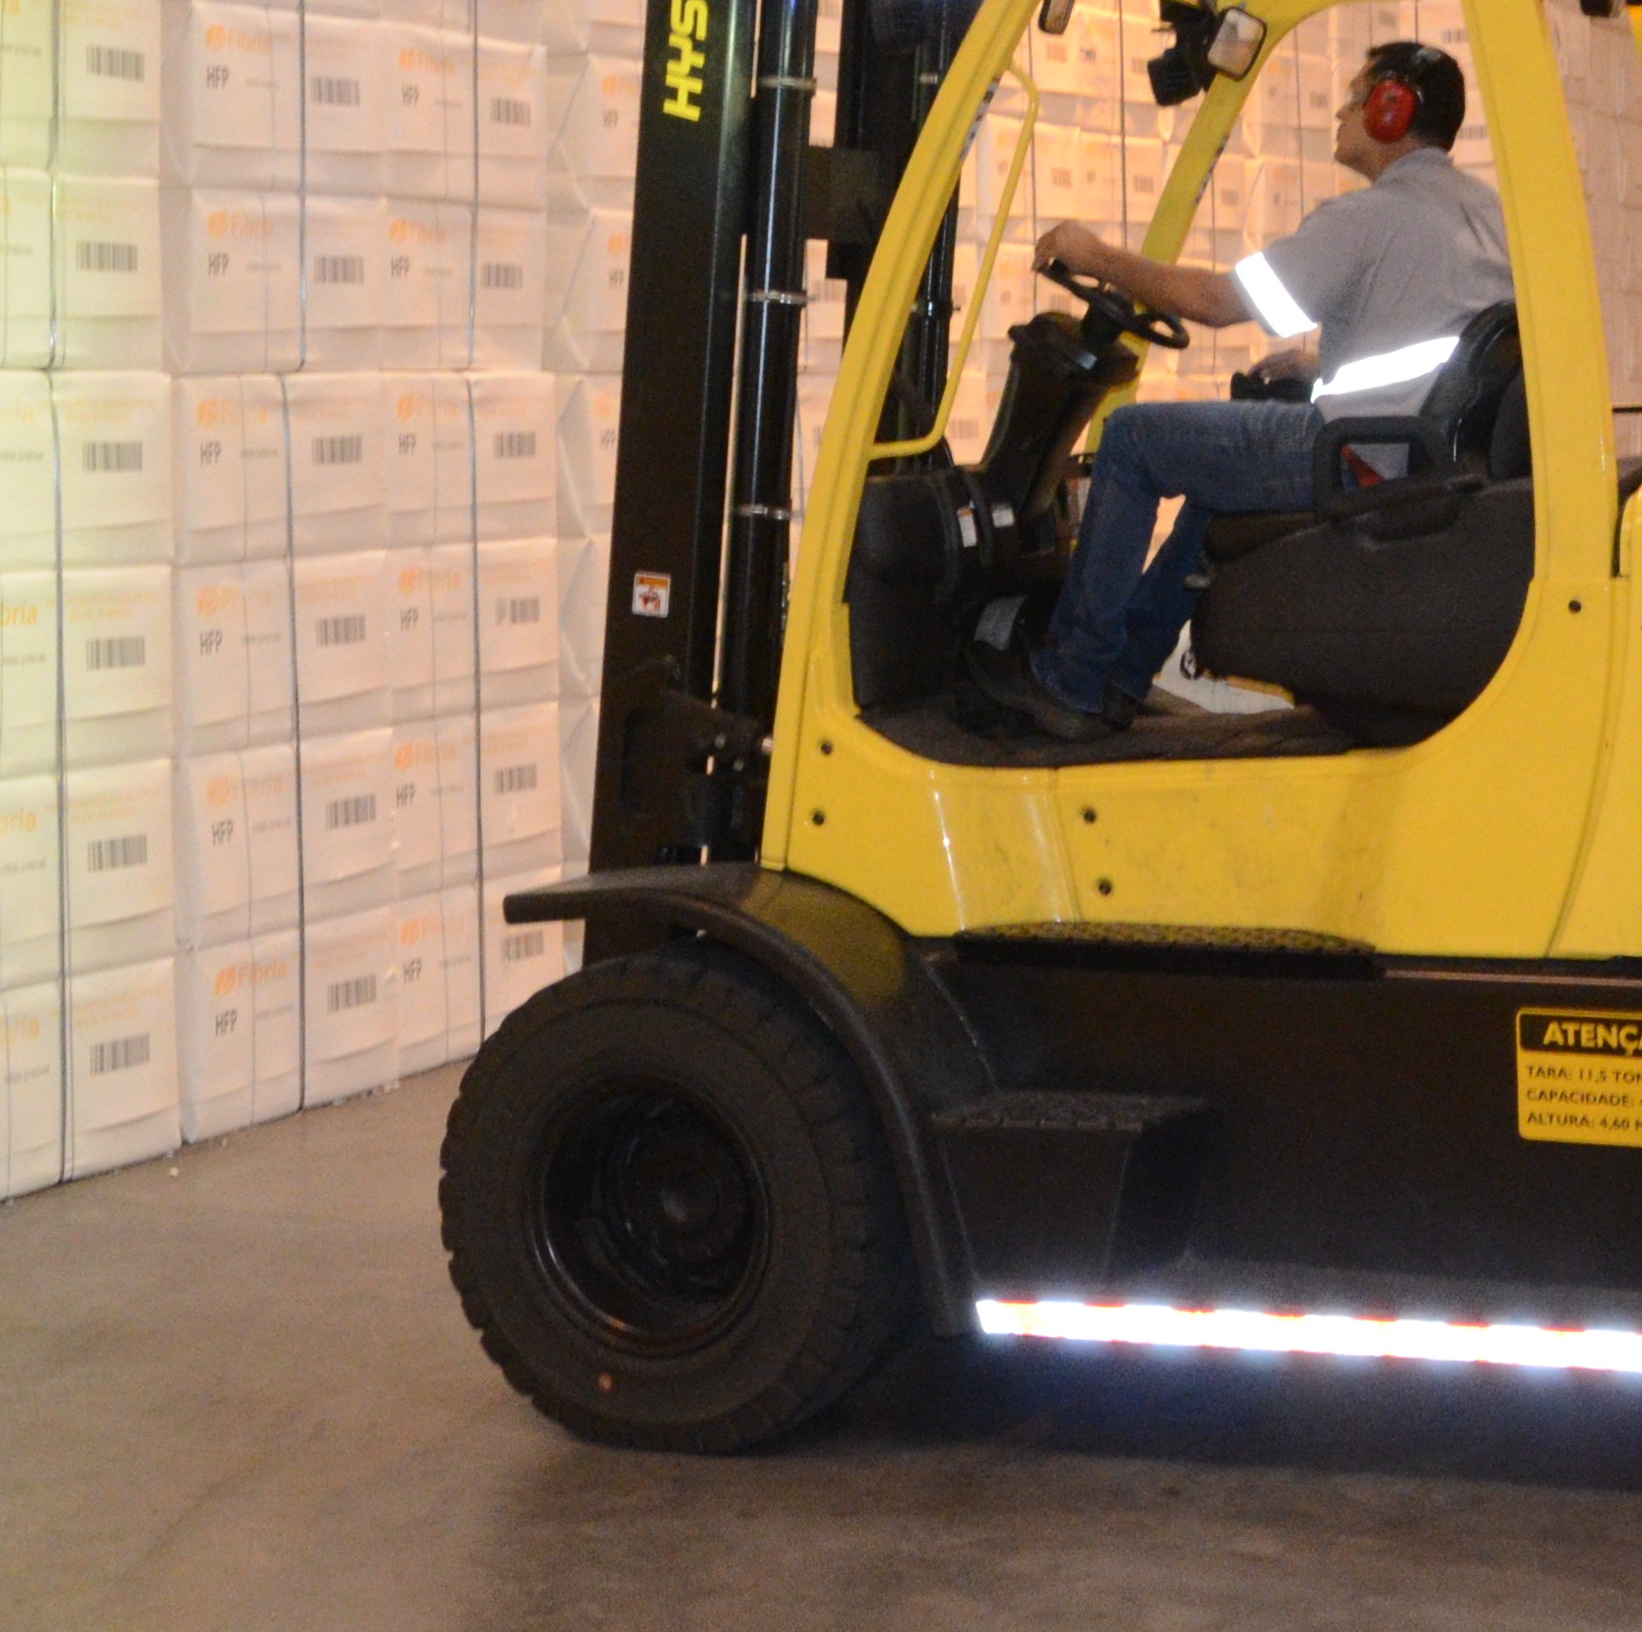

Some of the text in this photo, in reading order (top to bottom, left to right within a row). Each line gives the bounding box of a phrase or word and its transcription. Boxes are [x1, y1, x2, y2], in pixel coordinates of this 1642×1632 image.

[1527, 1066, 1572, 1079] TARA:
[1527, 1090, 1634, 1108] CAPACIDADE:
[1527, 1112, 1594, 1129] ALTURA:
